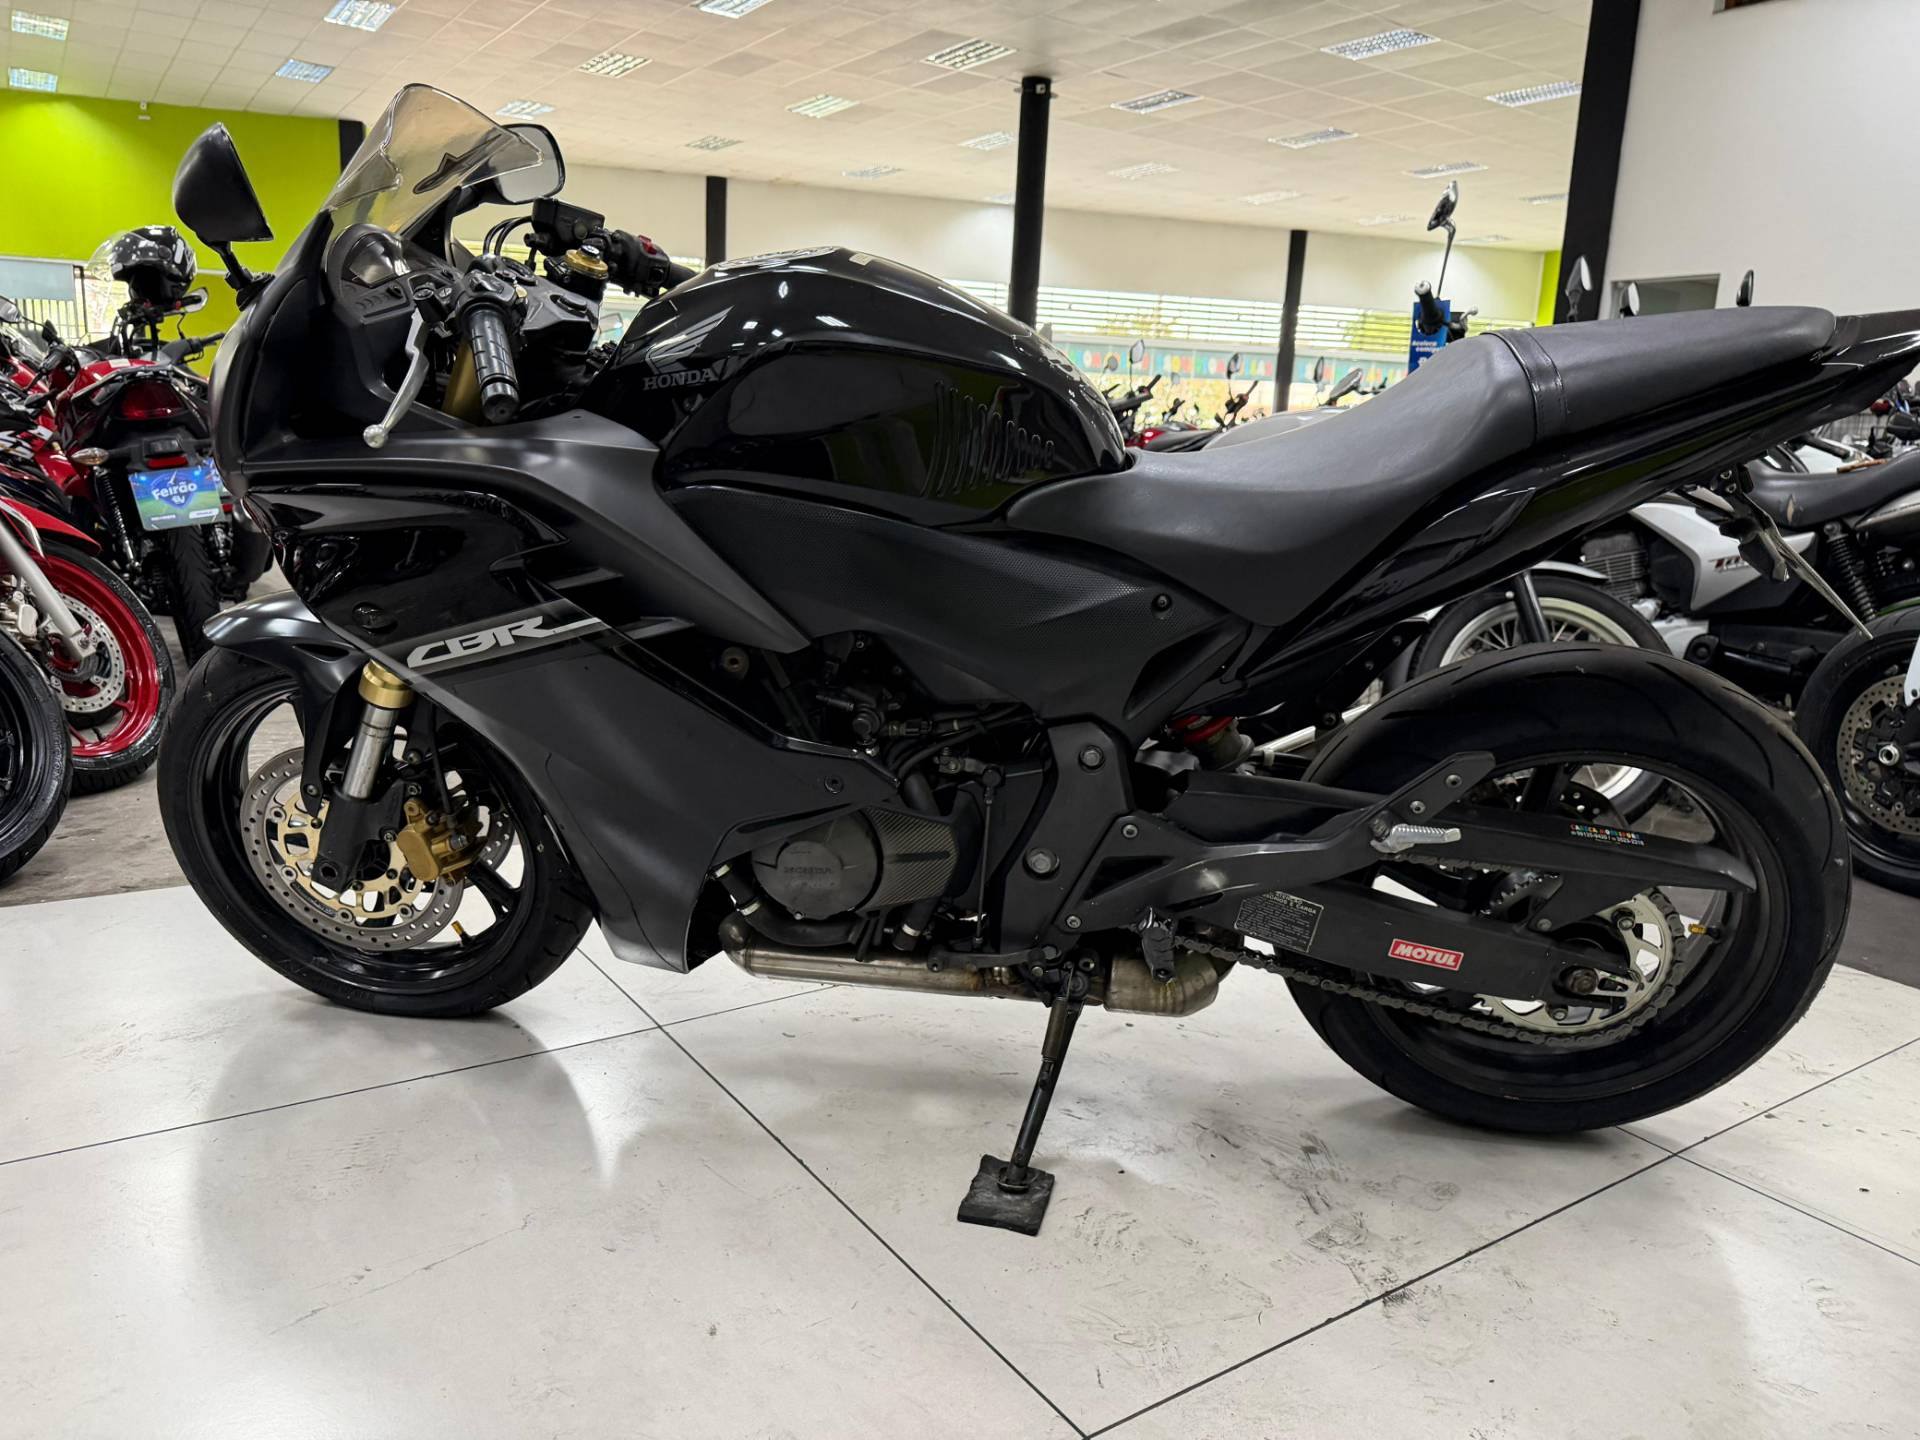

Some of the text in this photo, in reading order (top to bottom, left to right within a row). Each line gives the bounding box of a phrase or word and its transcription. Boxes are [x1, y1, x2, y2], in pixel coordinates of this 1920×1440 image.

[642, 368, 719, 390] HONDA
[152, 481, 197, 500] Feirão
[407, 615, 600, 669] CBR
[1393, 943, 1457, 967] MOTUL
